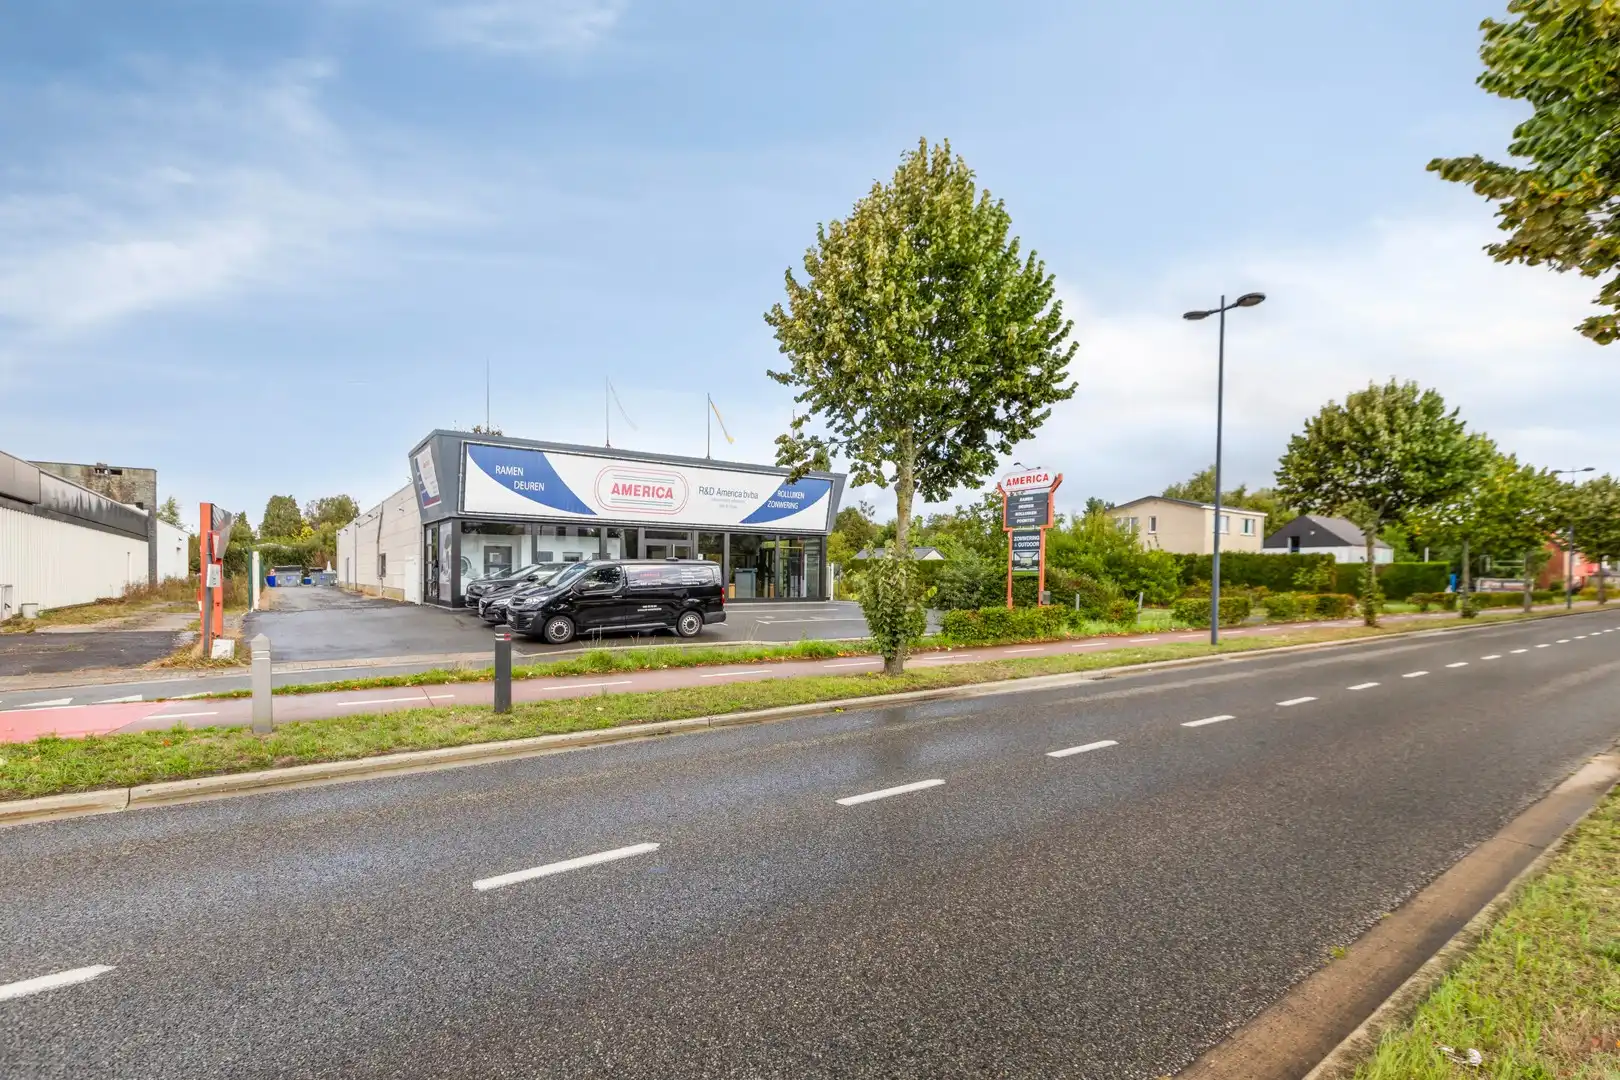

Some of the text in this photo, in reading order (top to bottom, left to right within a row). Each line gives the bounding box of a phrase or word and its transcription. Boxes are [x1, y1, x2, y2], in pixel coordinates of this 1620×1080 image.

[495, 465, 524, 477] RAMEN
[513, 480, 545, 492] DEUREN
[1006, 473, 1049, 487] AMERICA
[611, 482, 673, 499] AMERICA
[698, 486, 759, 499] R&D America bvba
[777, 489, 805, 500] ROLLUIKEN
[767, 500, 799, 510] ZONWERING
